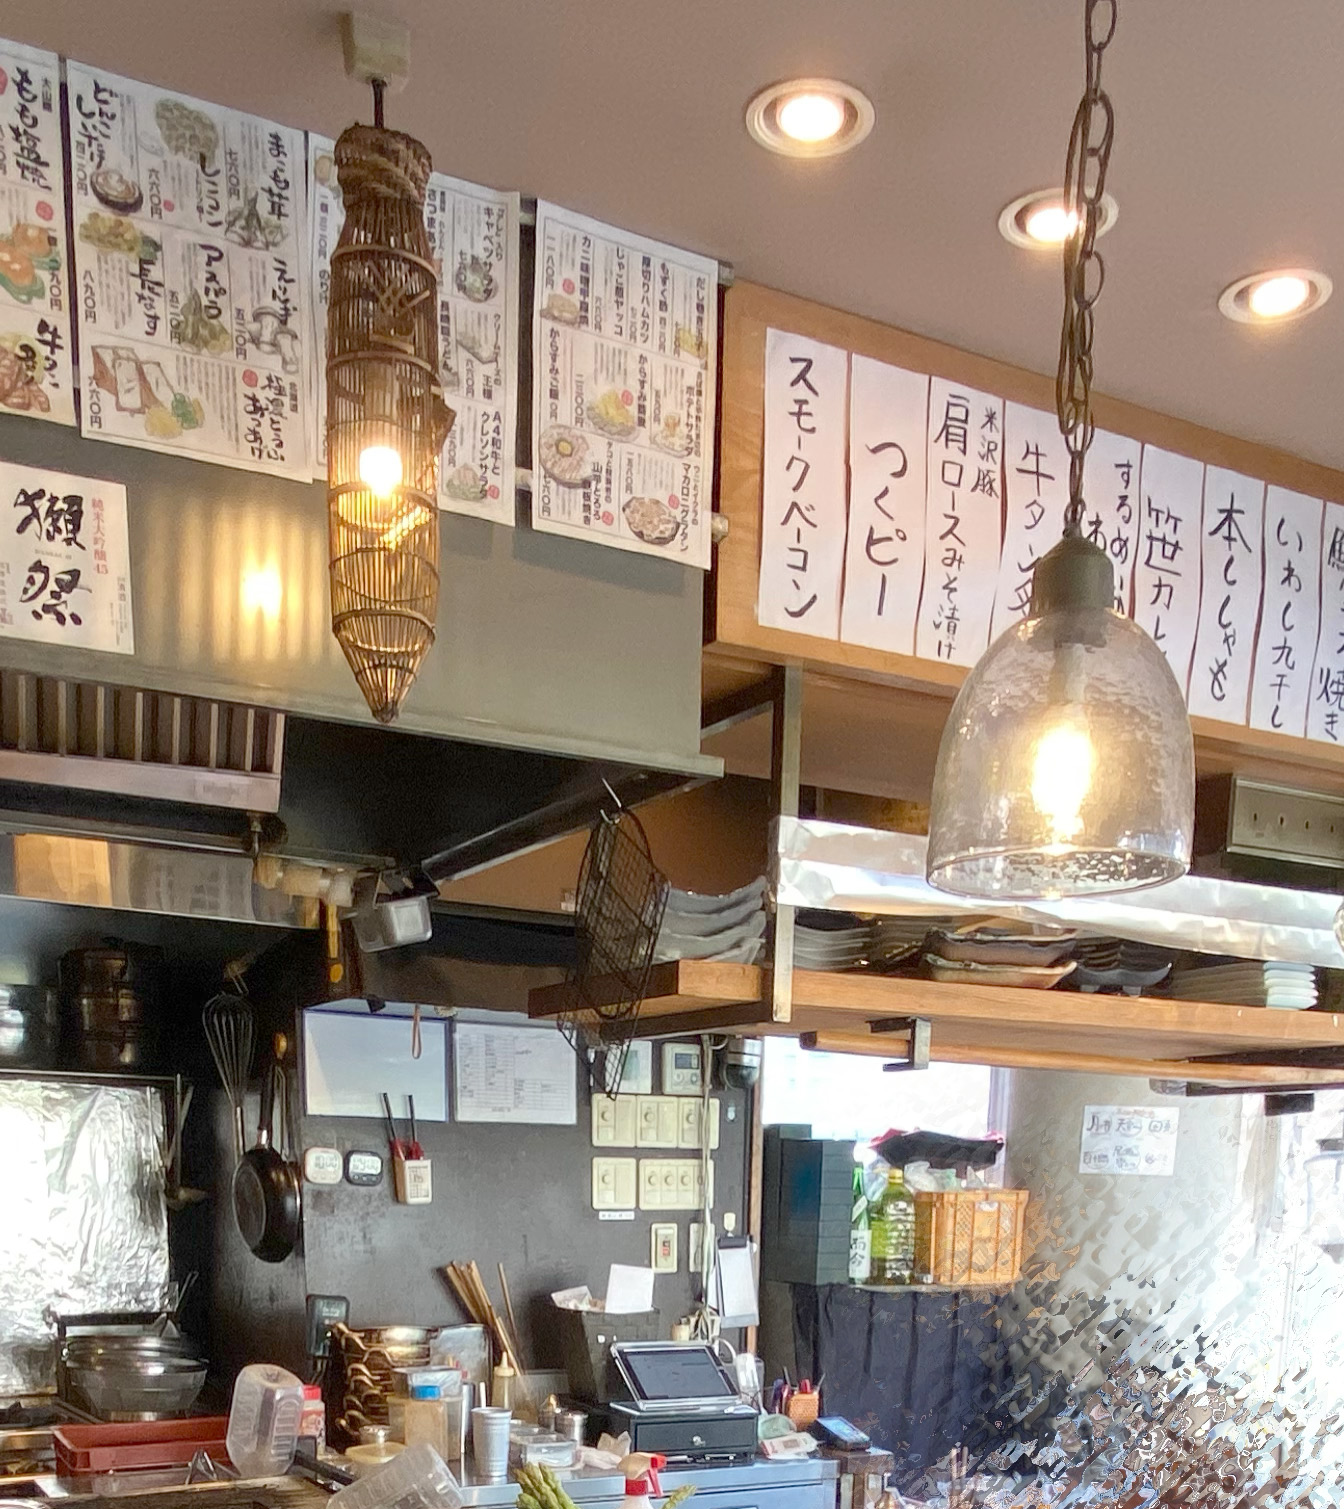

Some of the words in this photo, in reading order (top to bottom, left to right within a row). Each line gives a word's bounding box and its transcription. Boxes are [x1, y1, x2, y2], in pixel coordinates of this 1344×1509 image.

[780, 356, 820, 619] スモークベーコン
[864, 440, 909, 616] つくピー
[933, 393, 970, 660] 肩ロースみそ漬け
[971, 406, 1001, 499] 米沢豚
[1143, 495, 1186, 658] 笹カレ
[1209, 492, 1251, 702] 本ししゃも
